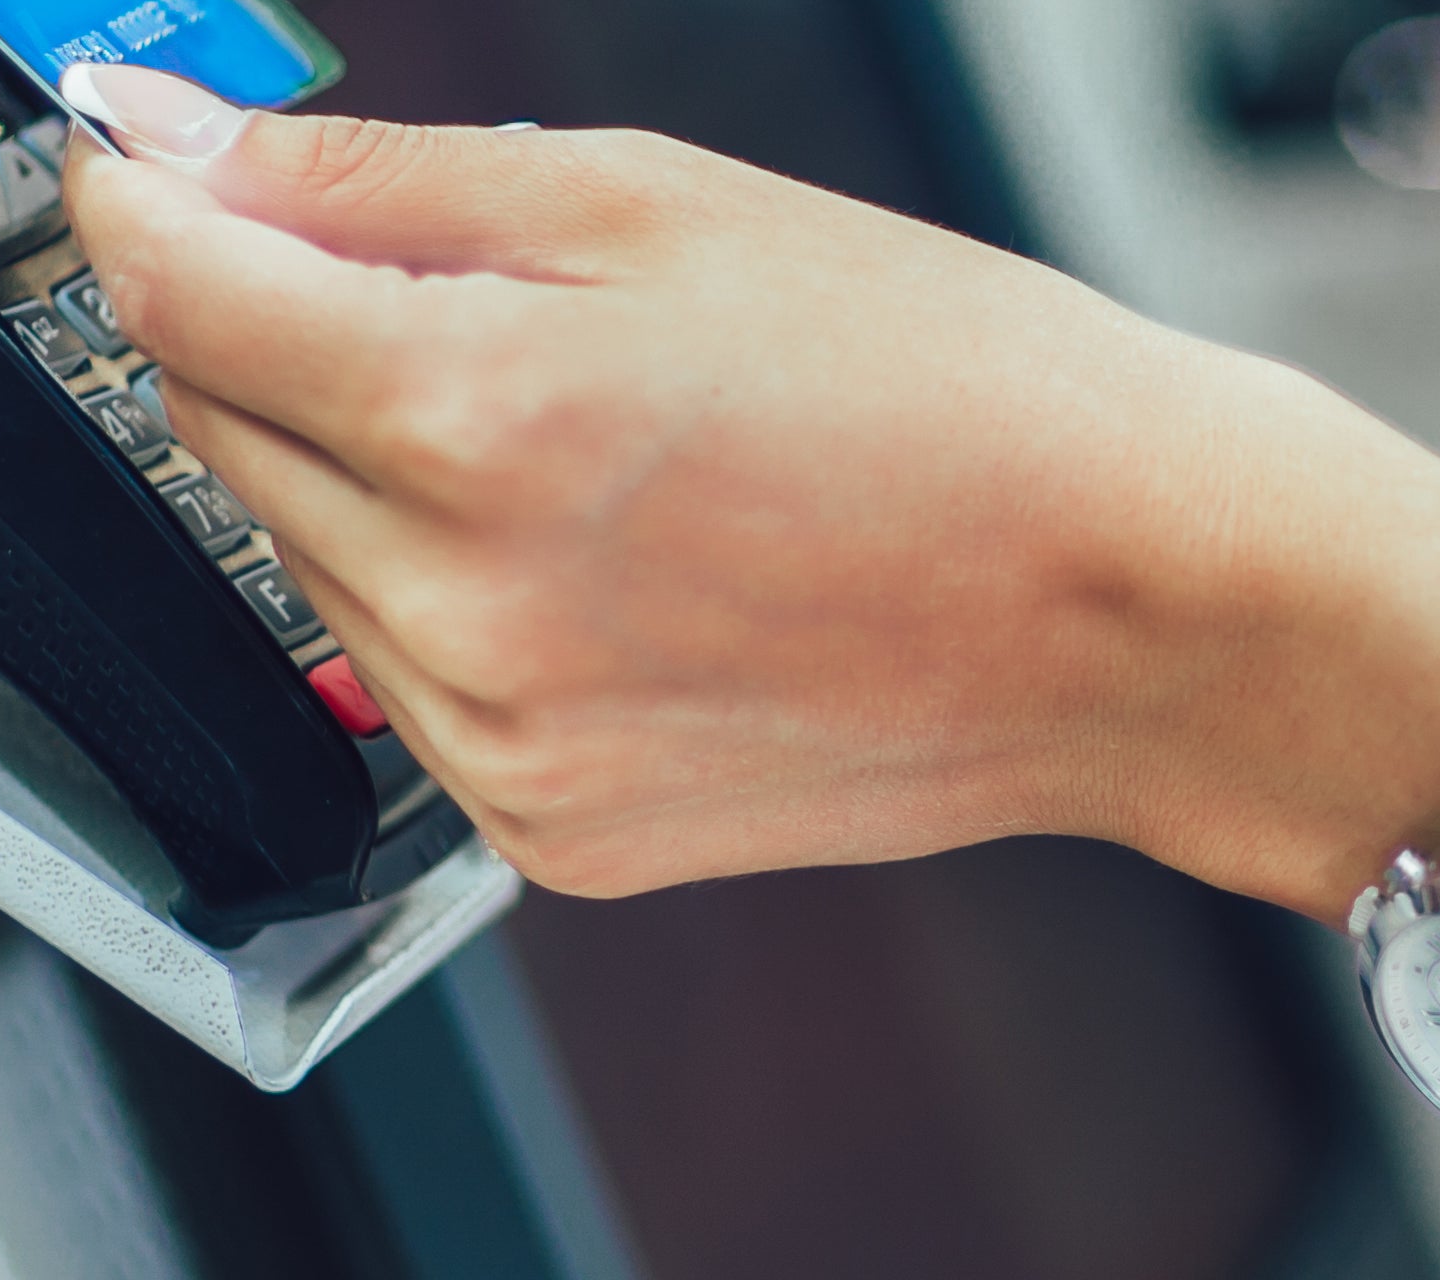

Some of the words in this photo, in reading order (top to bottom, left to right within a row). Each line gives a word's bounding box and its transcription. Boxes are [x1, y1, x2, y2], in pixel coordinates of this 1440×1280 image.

[82, 286, 118, 330] 2
[100, 405, 136, 447] 4
[174, 491, 213, 534] 7
[257, 578, 292, 623] F
